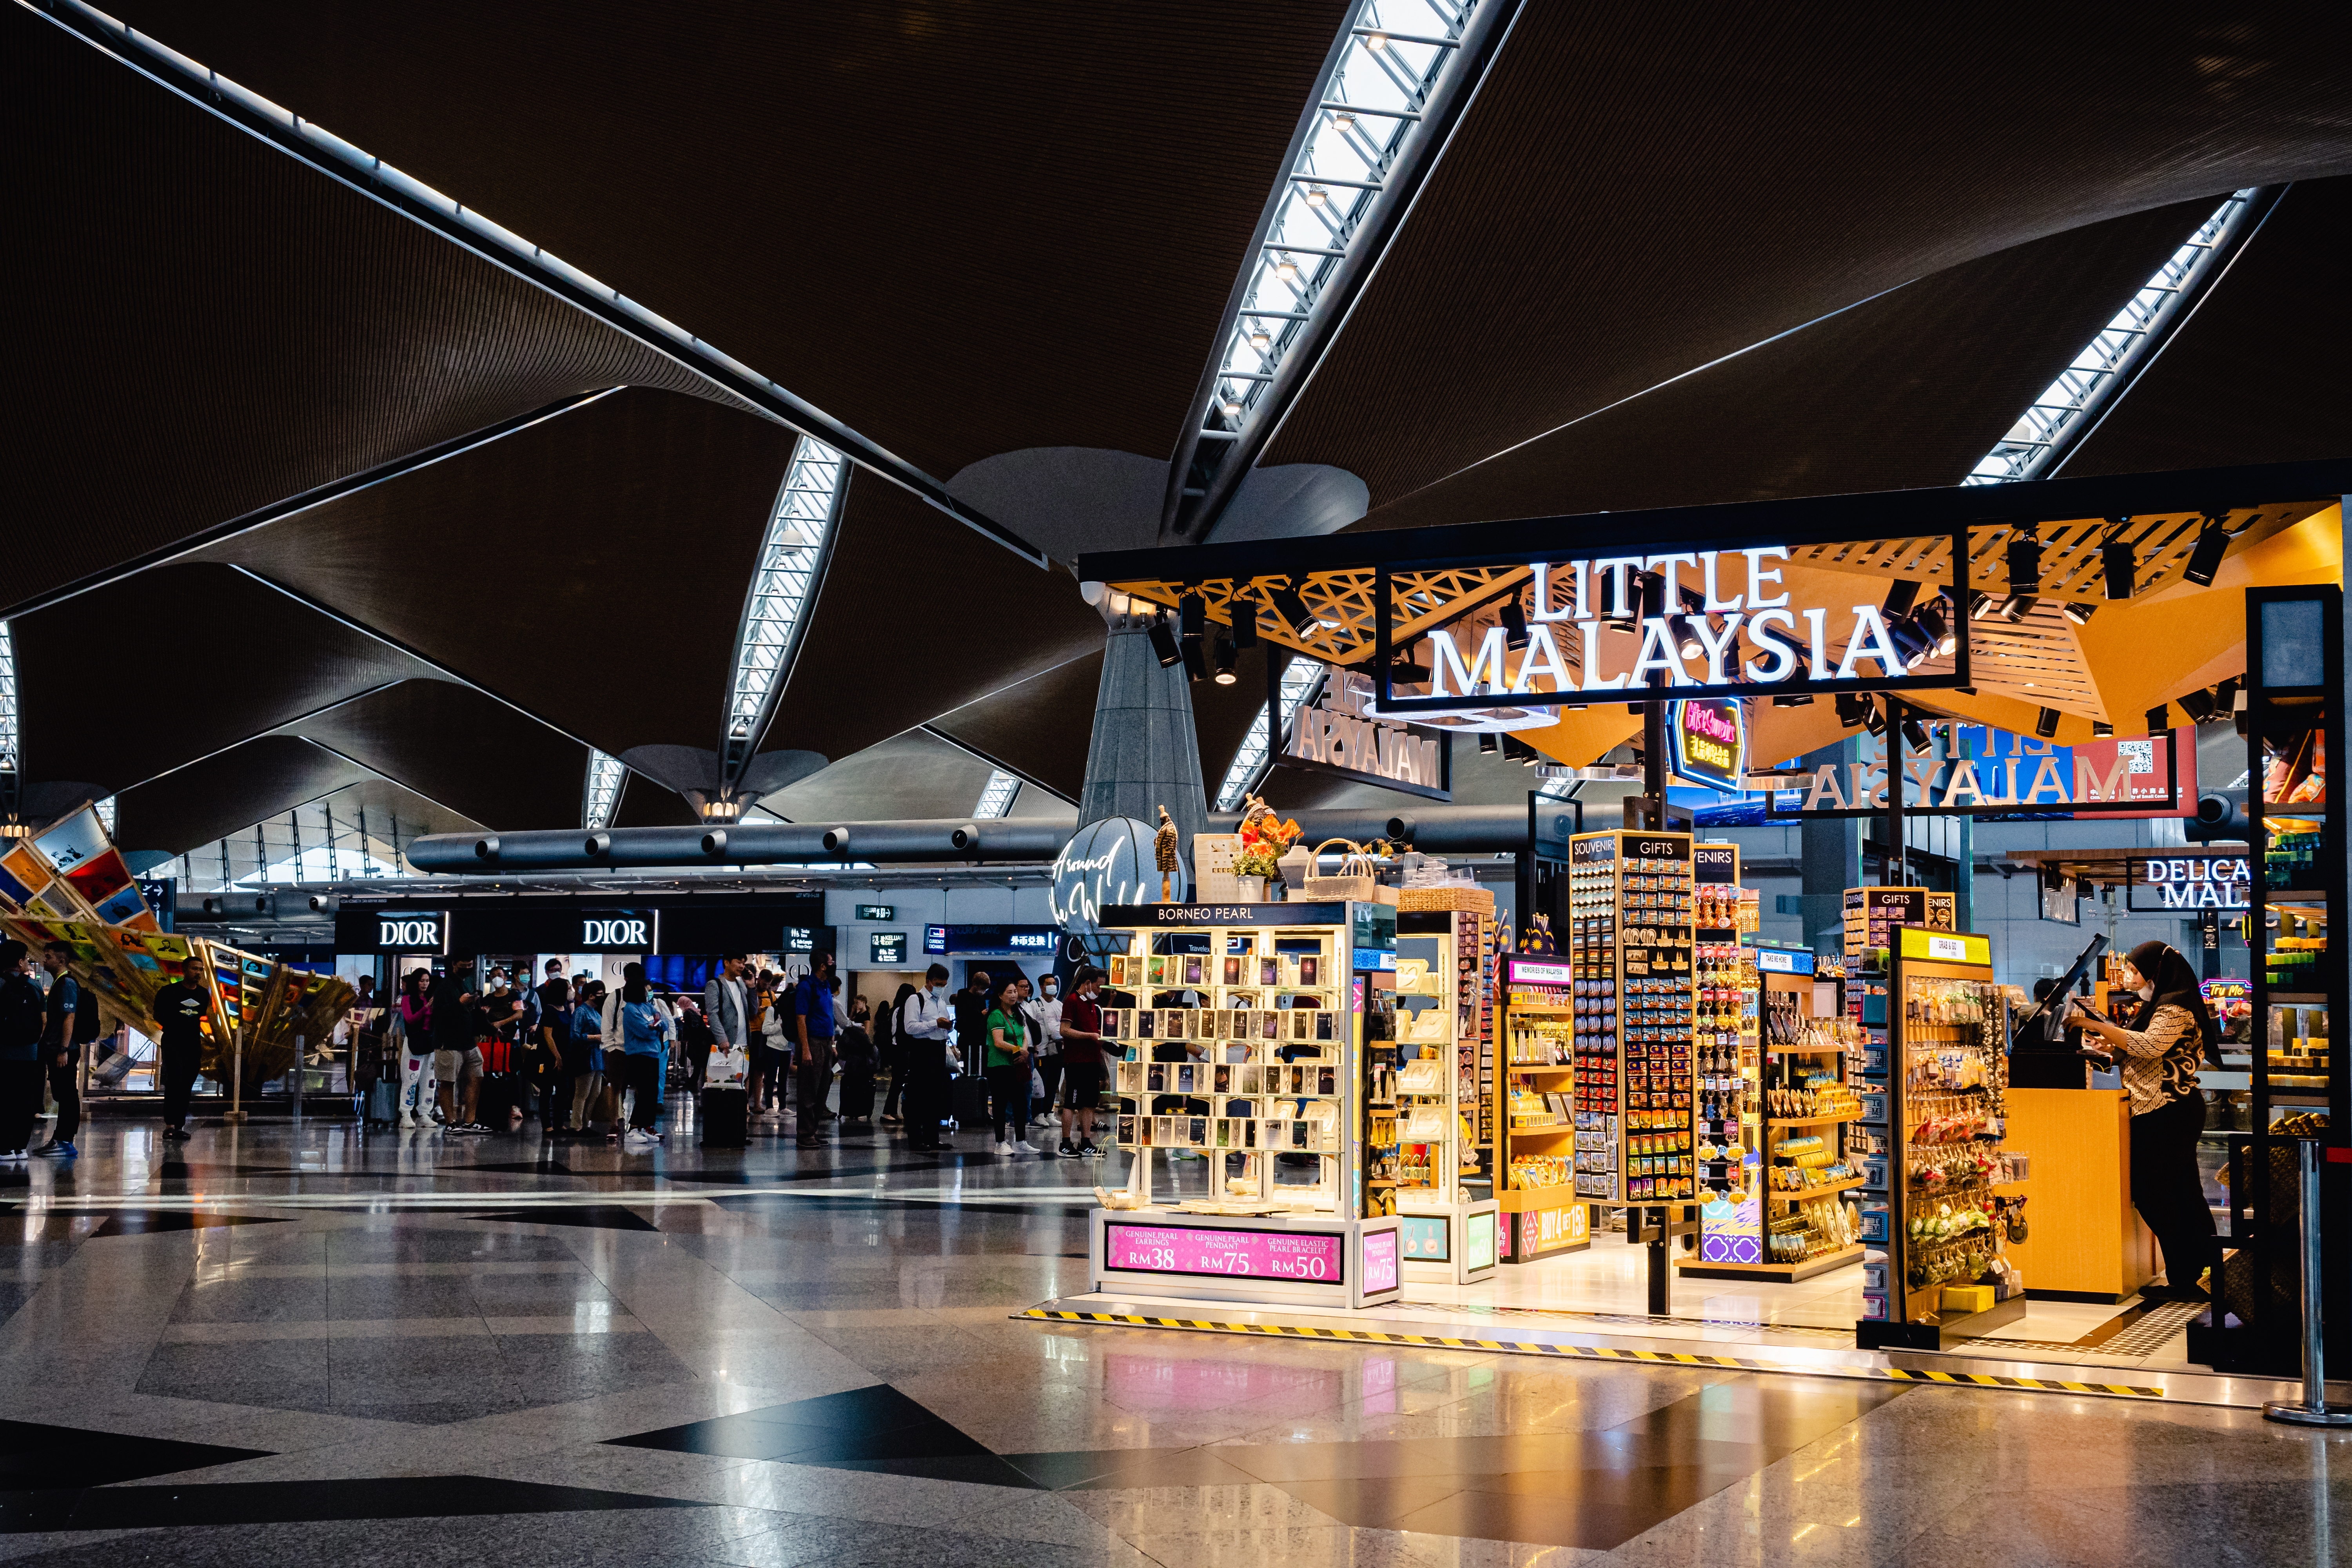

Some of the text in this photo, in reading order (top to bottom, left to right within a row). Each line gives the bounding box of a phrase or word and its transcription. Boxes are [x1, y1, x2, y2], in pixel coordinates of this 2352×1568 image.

[1529, 546, 1790, 621] LITTLE
[1427, 605, 1907, 698] MALAYSIA
[1575, 839, 1615, 855] SOUVENIRS
[1640, 842, 1672, 854] GIFTS
[1052, 835, 1125, 886] Around
[2147, 859, 2250, 881] DELICA
[1882, 895, 1910, 904] GIFTS
[2163, 882, 2250, 907] MAL
[1159, 907, 1253, 920] BORNEO PEARL
[380, 922, 439, 945] DIOR
[583, 920, 648, 944] DIOR
[1011, 936, 1045, 946] 外币兑换
[1939, 940, 1947, 949] GRAB
[2229, 984, 2244, 996] Me
[1542, 1211, 1556, 1240] BUY
[1556, 1208, 1562, 1239] 4
[1563, 1213, 1571, 1231] GET
[1206, 1241, 1239, 1250] PENDANT
[1368, 1242, 1382, 1250] GENUINE
[1372, 1248, 1387, 1257] PENDANT
[1129, 1248, 1175, 1269] RM38
[1201, 1252, 1249, 1274] RM75
[1272, 1256, 1325, 1278] RM50
[1368, 1258, 1392, 1280] RM75
